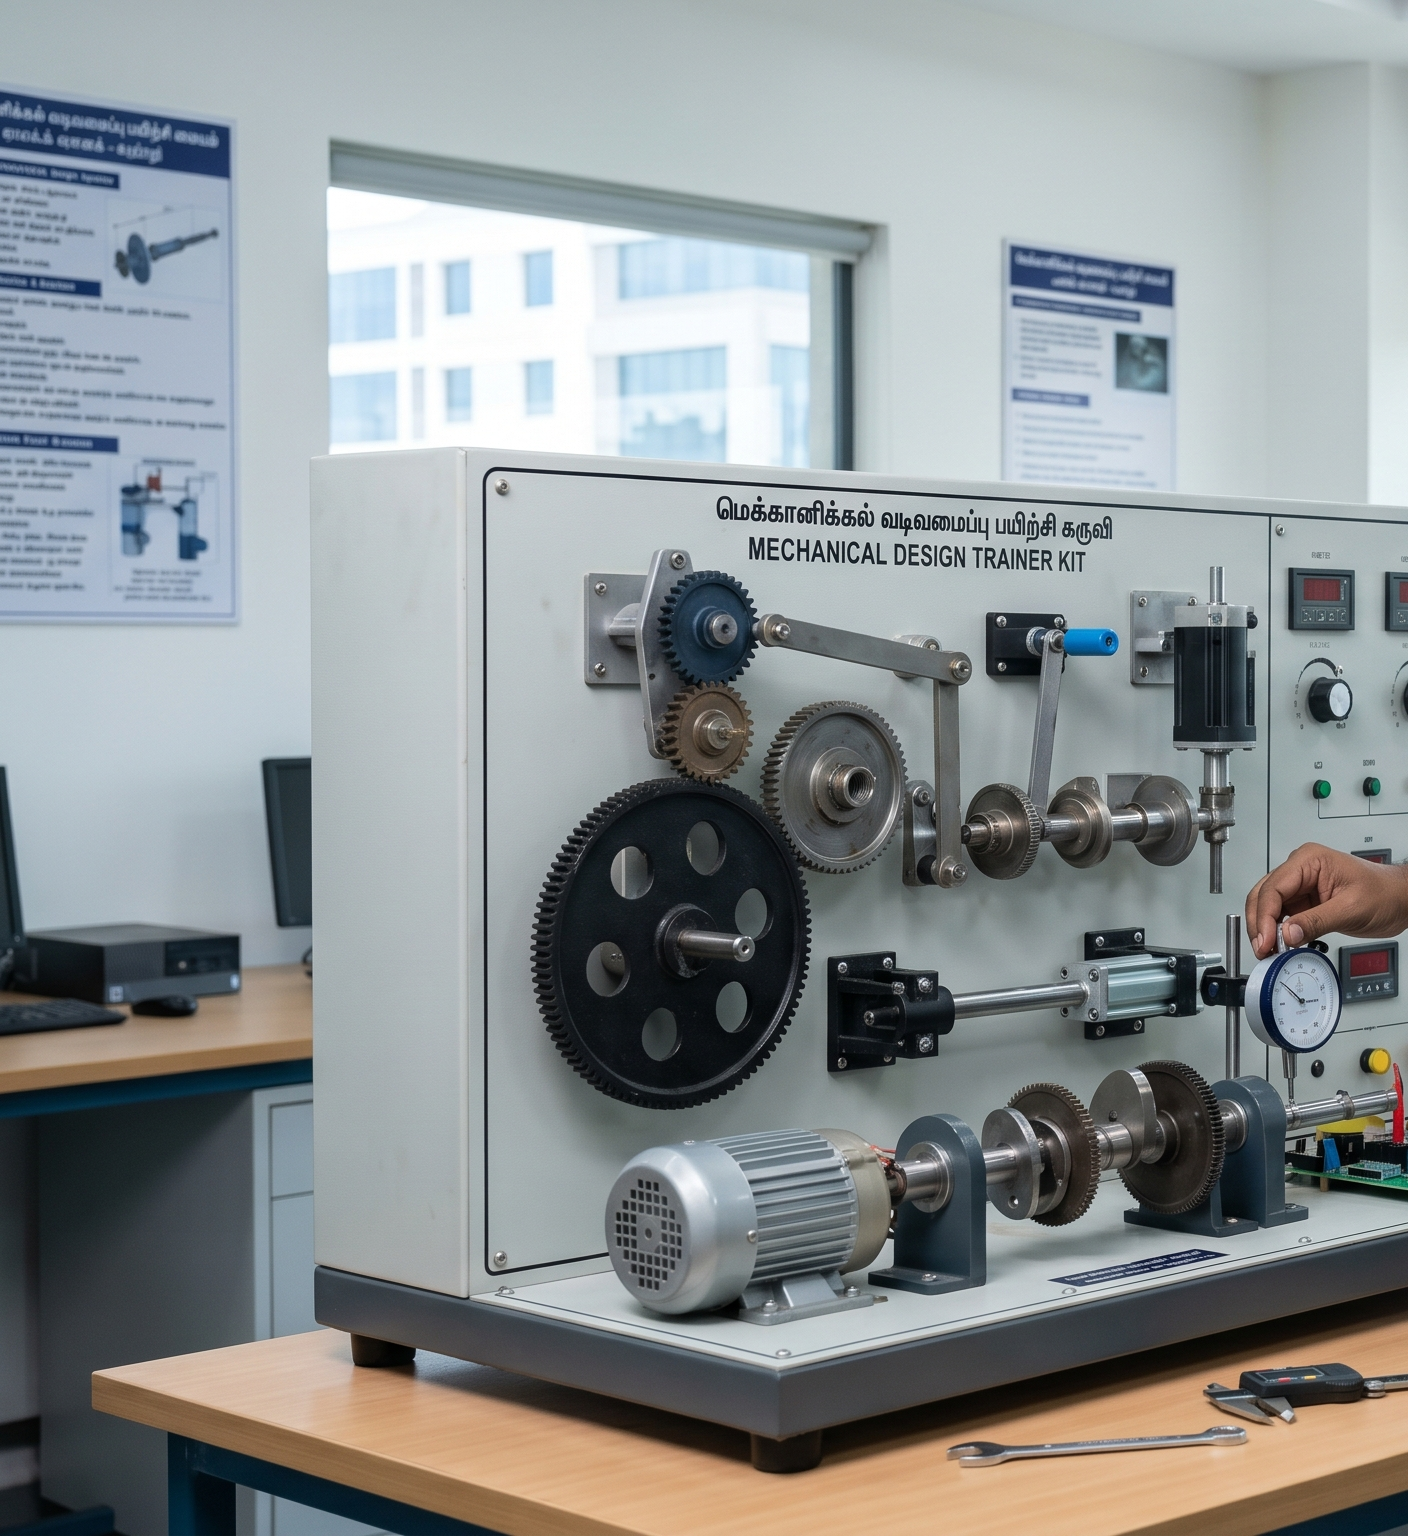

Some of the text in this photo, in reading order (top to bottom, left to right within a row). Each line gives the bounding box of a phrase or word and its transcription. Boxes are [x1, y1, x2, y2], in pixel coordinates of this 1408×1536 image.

[716, 495, 1113, 546] மெக்கானிக்கல் வடிவமைப்பு பயிற்சி கருவி
[748, 536, 1086, 573] MECHANICAL DESIGN TRAINER KIT
